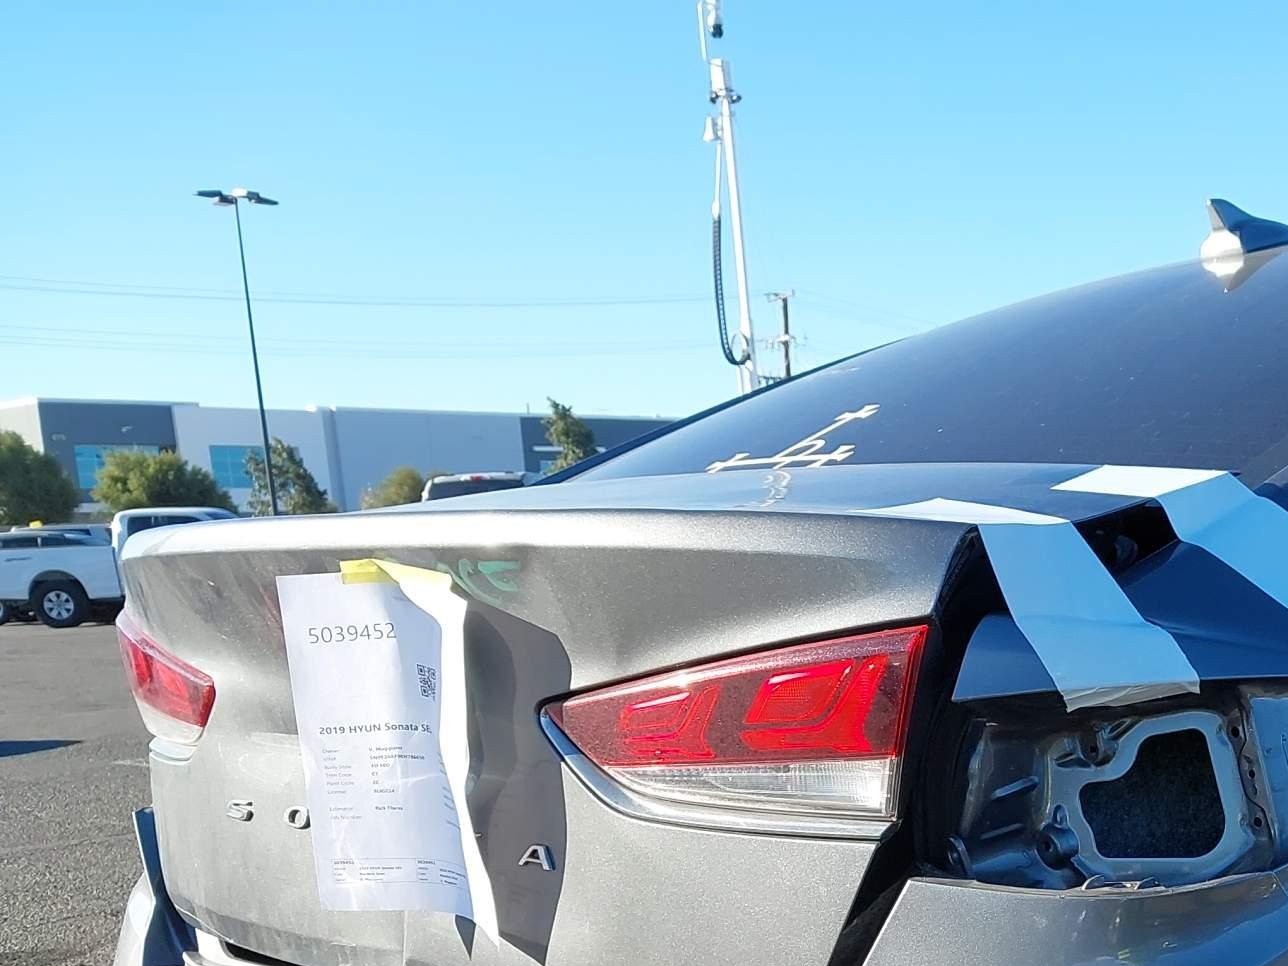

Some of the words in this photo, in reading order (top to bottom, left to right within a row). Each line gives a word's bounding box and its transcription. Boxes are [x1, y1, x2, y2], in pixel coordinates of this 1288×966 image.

[308, 622, 397, 644] 5039452
[319, 725, 346, 735] 2019
[349, 723, 381, 734] HYUN
[384, 721, 419, 732] Sonata
